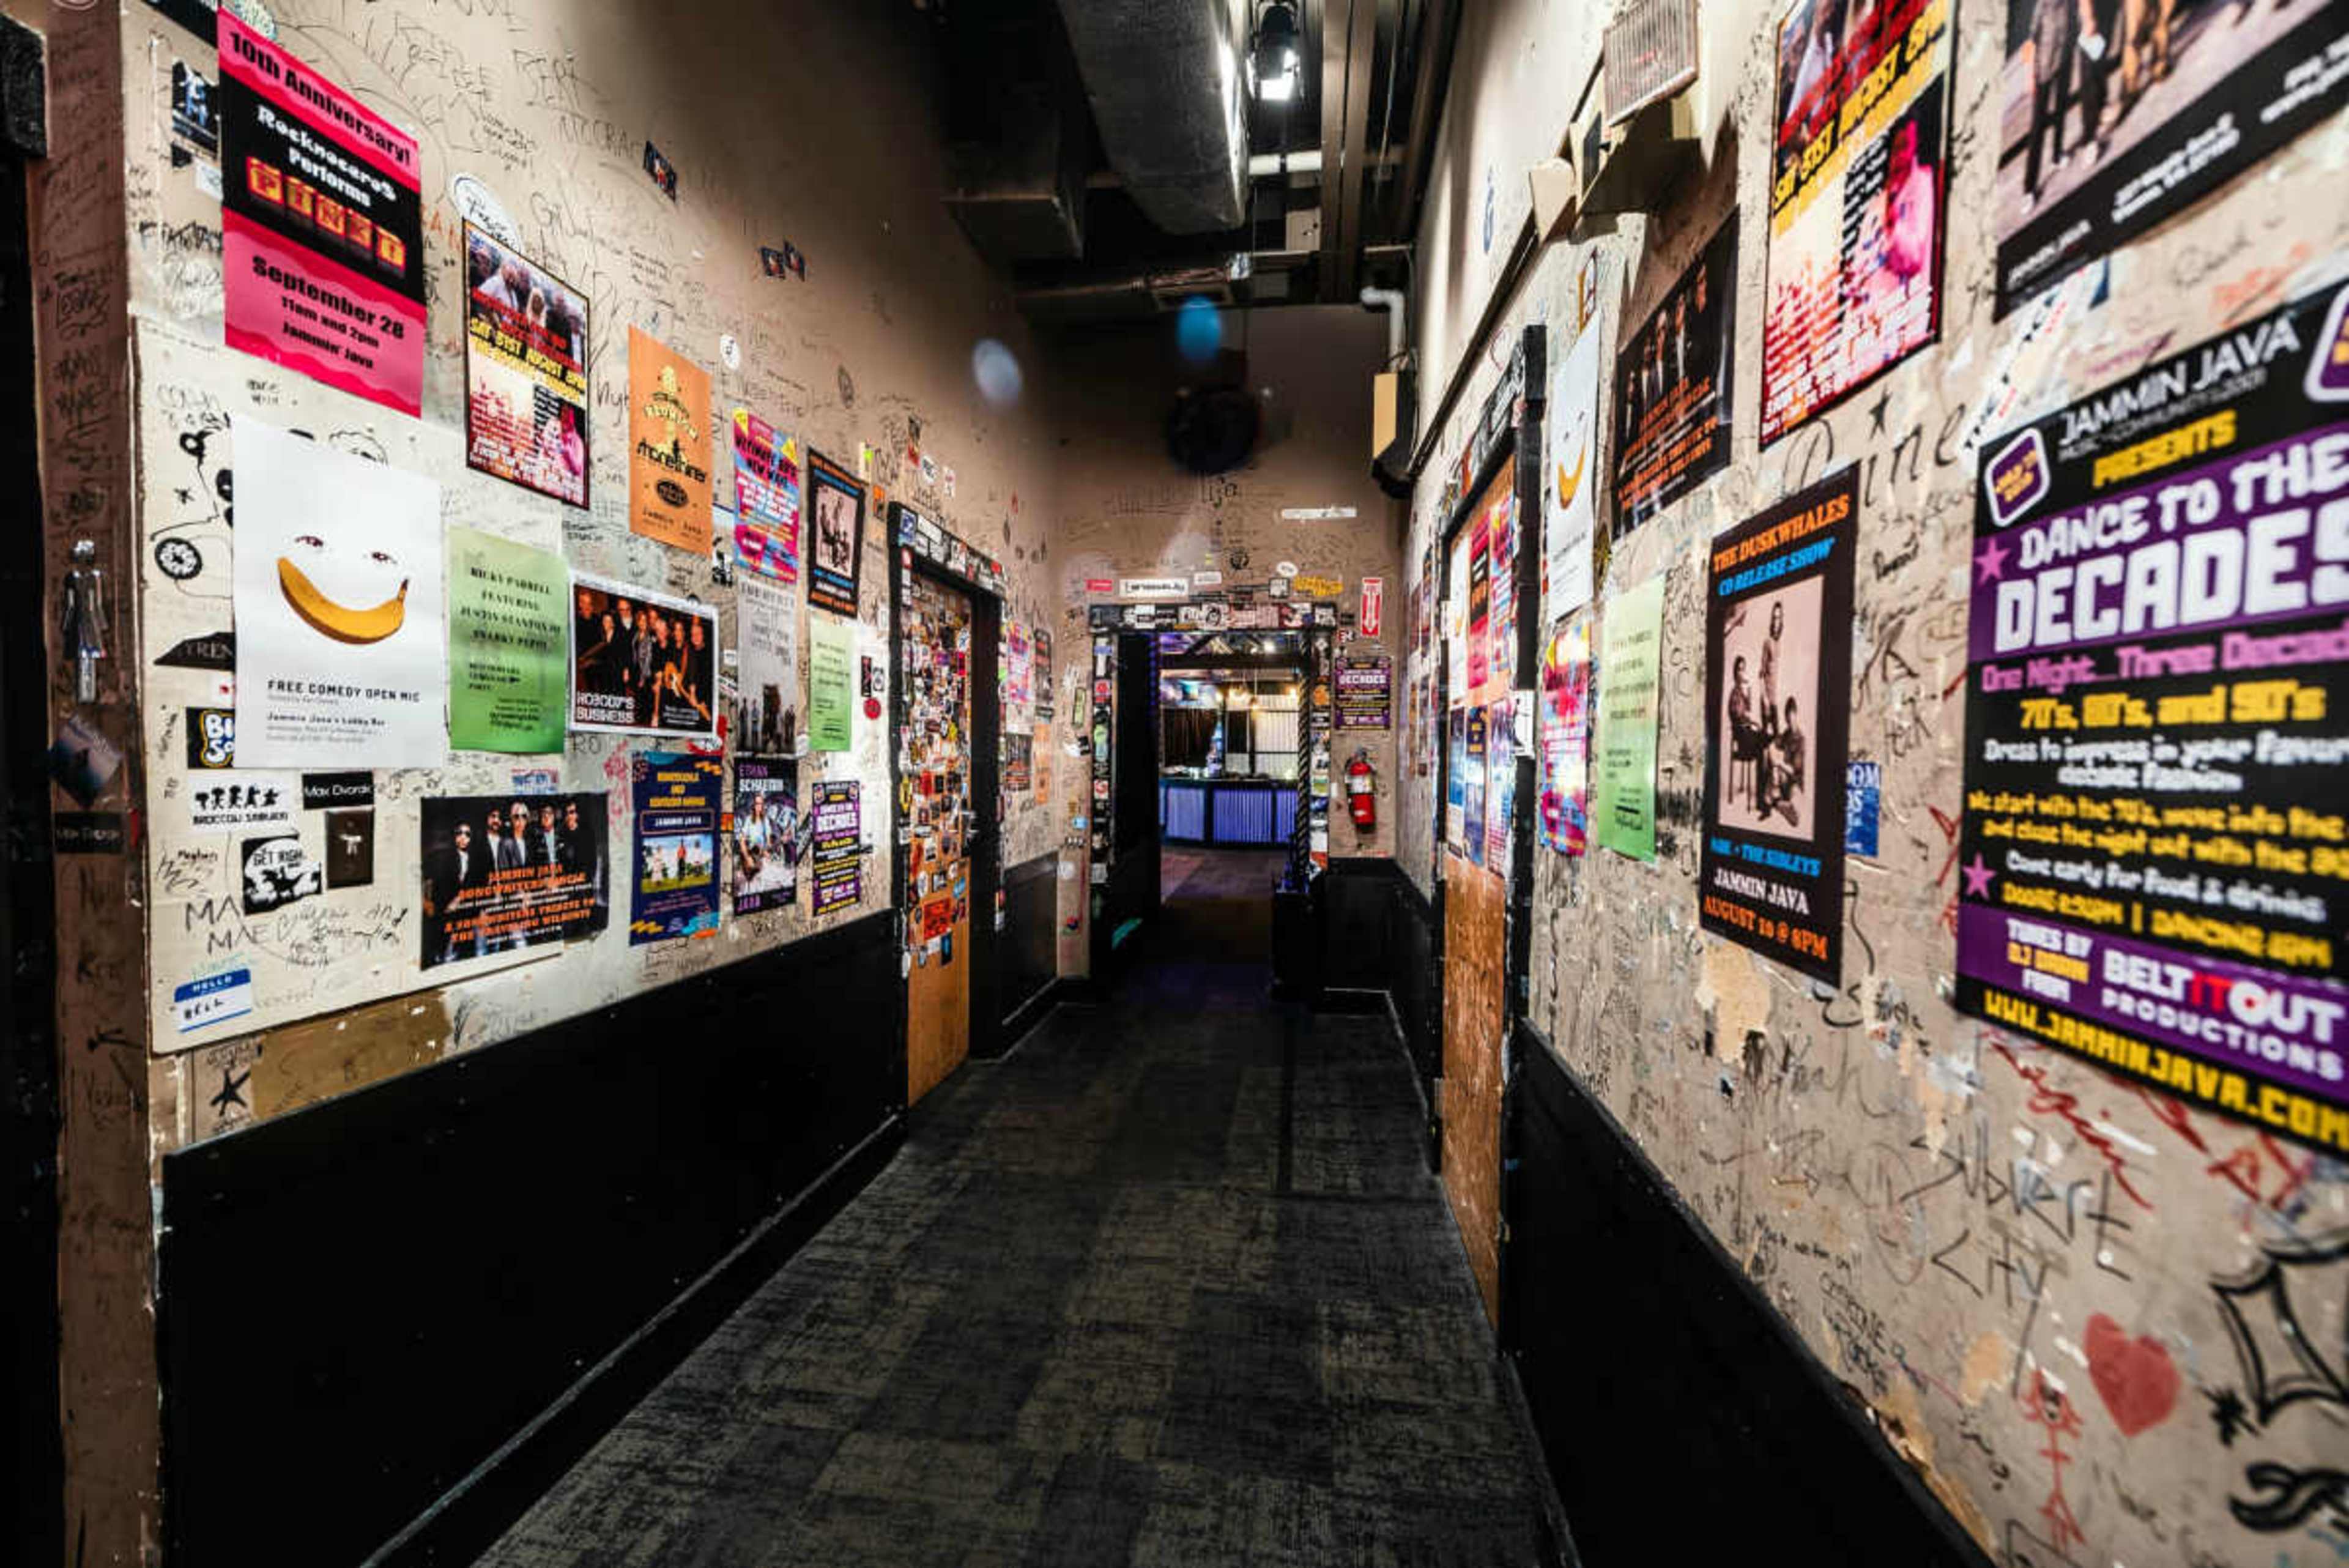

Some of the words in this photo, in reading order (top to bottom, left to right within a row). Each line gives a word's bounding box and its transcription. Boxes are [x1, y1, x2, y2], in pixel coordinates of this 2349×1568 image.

[253, 256, 376, 327] September
[379, 314, 404, 339] 28
[321, 309, 347, 335] and
[349, 324, 380, 350] 2pm
[344, 347, 374, 370] Java
[2058, 360, 2186, 445] JAMMIN
[2192, 310, 2302, 392] JAVA
[2093, 408, 2237, 488] PRESENTS
[2019, 496, 2151, 570] DANCE
[2157, 479, 2221, 532] TO
[1713, 545, 1739, 574] THE
[267, 680, 304, 693] FREE
[308, 683, 362, 698] COMEDY
[366, 688, 396, 700] OPEN
[400, 691, 420, 703] MIC
[1983, 665, 2022, 693] One
[577, 708, 635, 724] BUSINESS
[2157, 685, 2227, 724] and
[2231, 678, 2326, 722] 90's
[306, 784, 329, 797] Max
[1714, 867, 1767, 899] JAMMIN
[1767, 883, 1810, 915] JAVA
[1704, 894, 1756, 932] AUGUST
[193, 975, 232, 992] HELLO
[2101, 989, 2344, 1082] PRODUCTIONS
